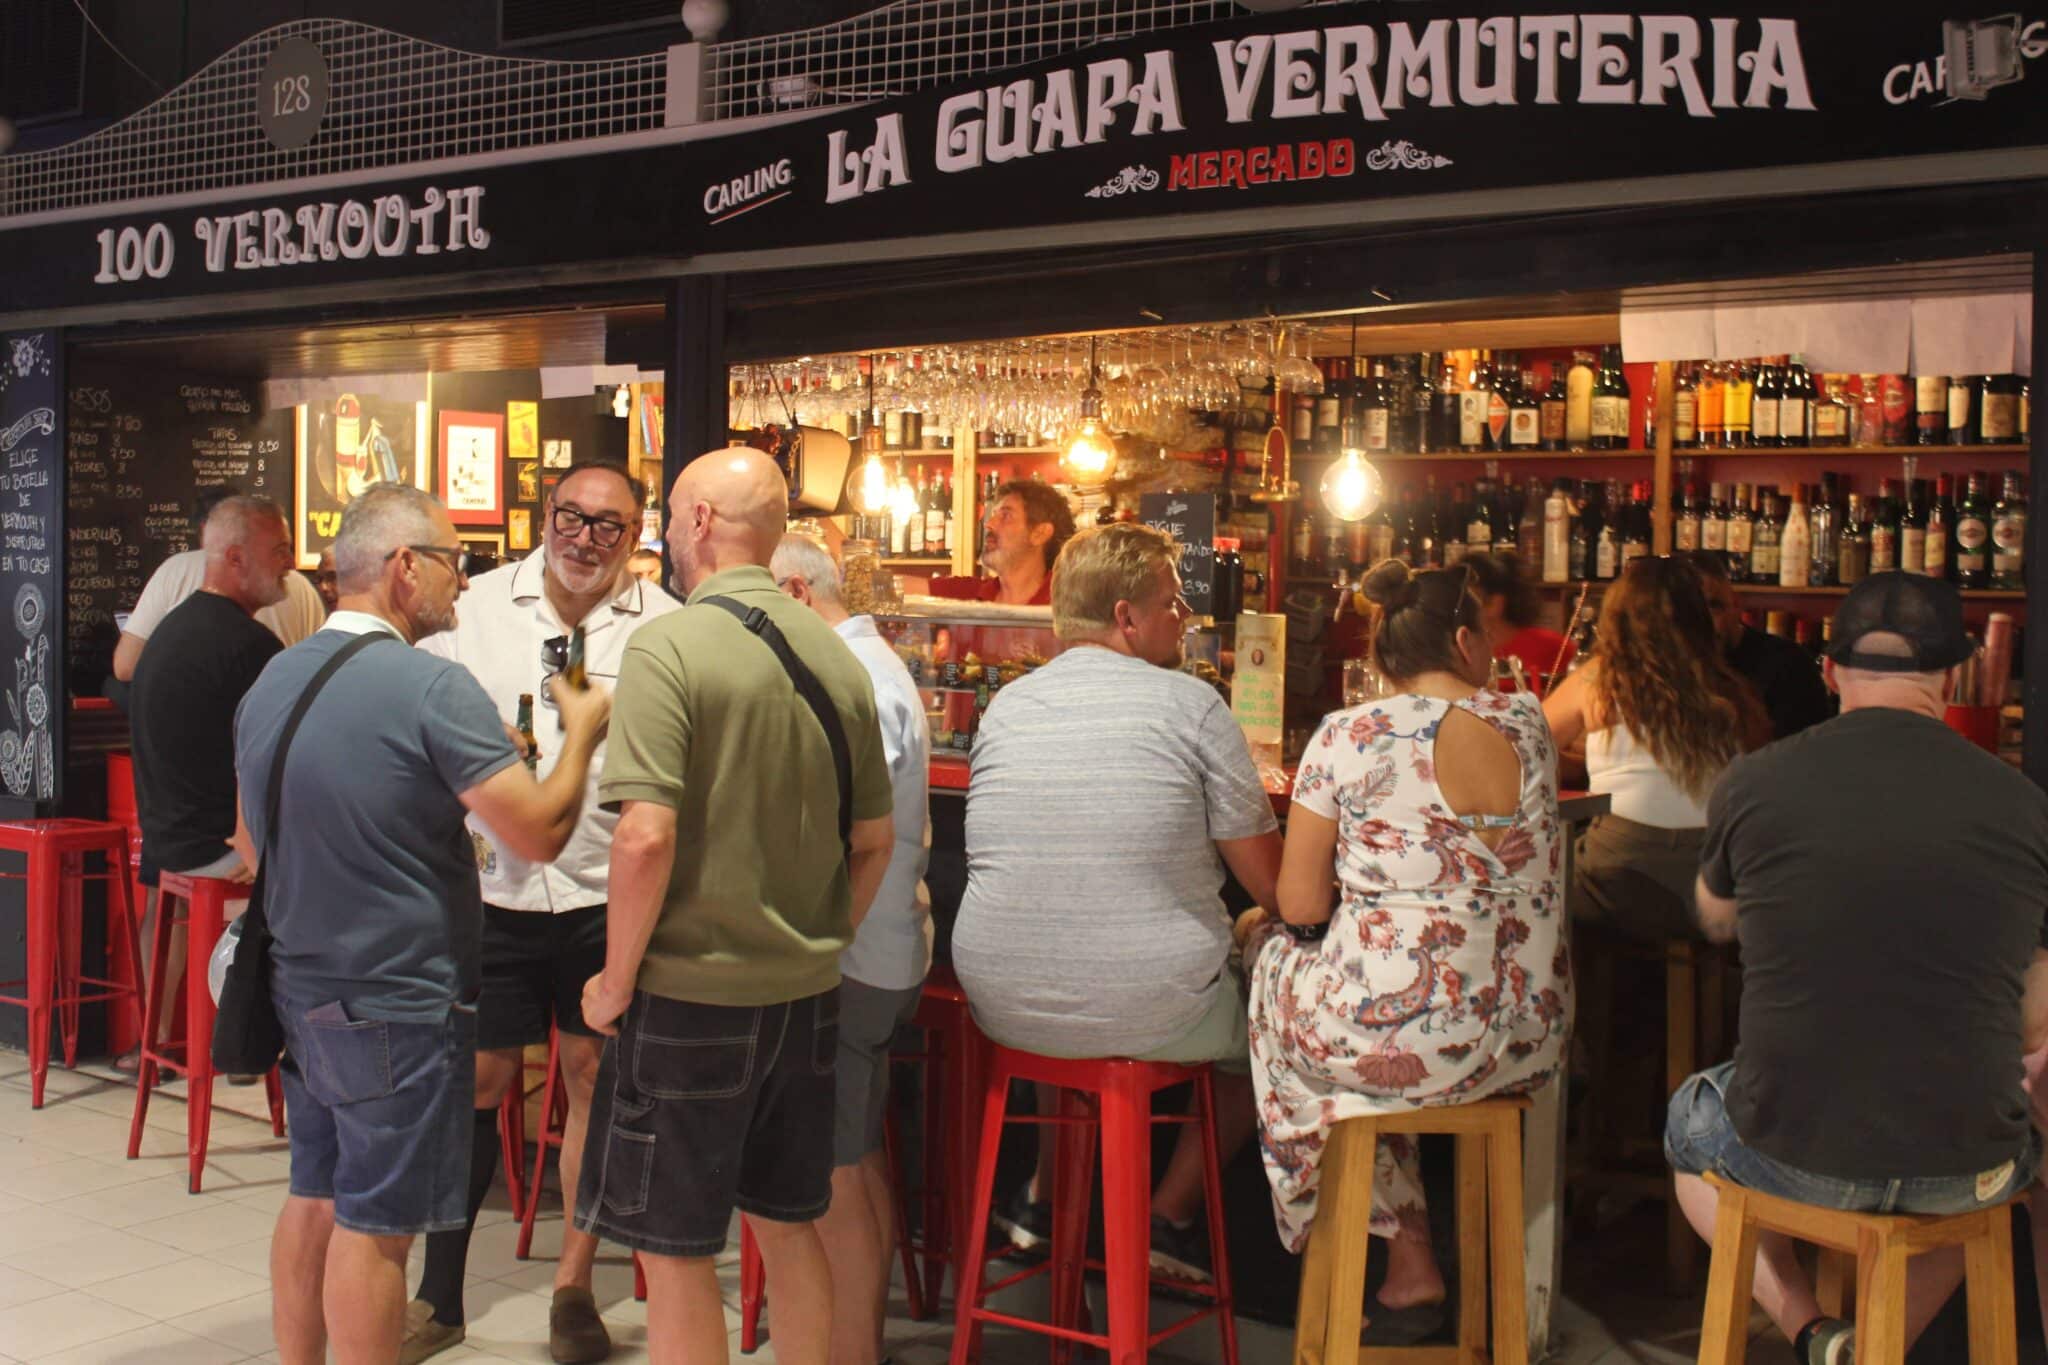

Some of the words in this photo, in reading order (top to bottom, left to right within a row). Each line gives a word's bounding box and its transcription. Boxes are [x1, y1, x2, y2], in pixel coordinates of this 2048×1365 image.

[826, 112, 911, 204] LA
[935, 49, 1186, 173] GUAPA
[1212, 14, 1817, 124] VERMUTERIA
[1167, 137, 1354, 190] MERCADO
[703, 158, 792, 216] CARLING
[94, 223, 173, 283] 100
[194, 186, 490, 273] VERMOUTH
[9, 448, 39, 469] ELIGE
[12, 470, 49, 491] BOTELLA
[18, 492, 32, 508] DE
[15, 556, 28, 572] TU
[29, 556, 50, 575] CASA
